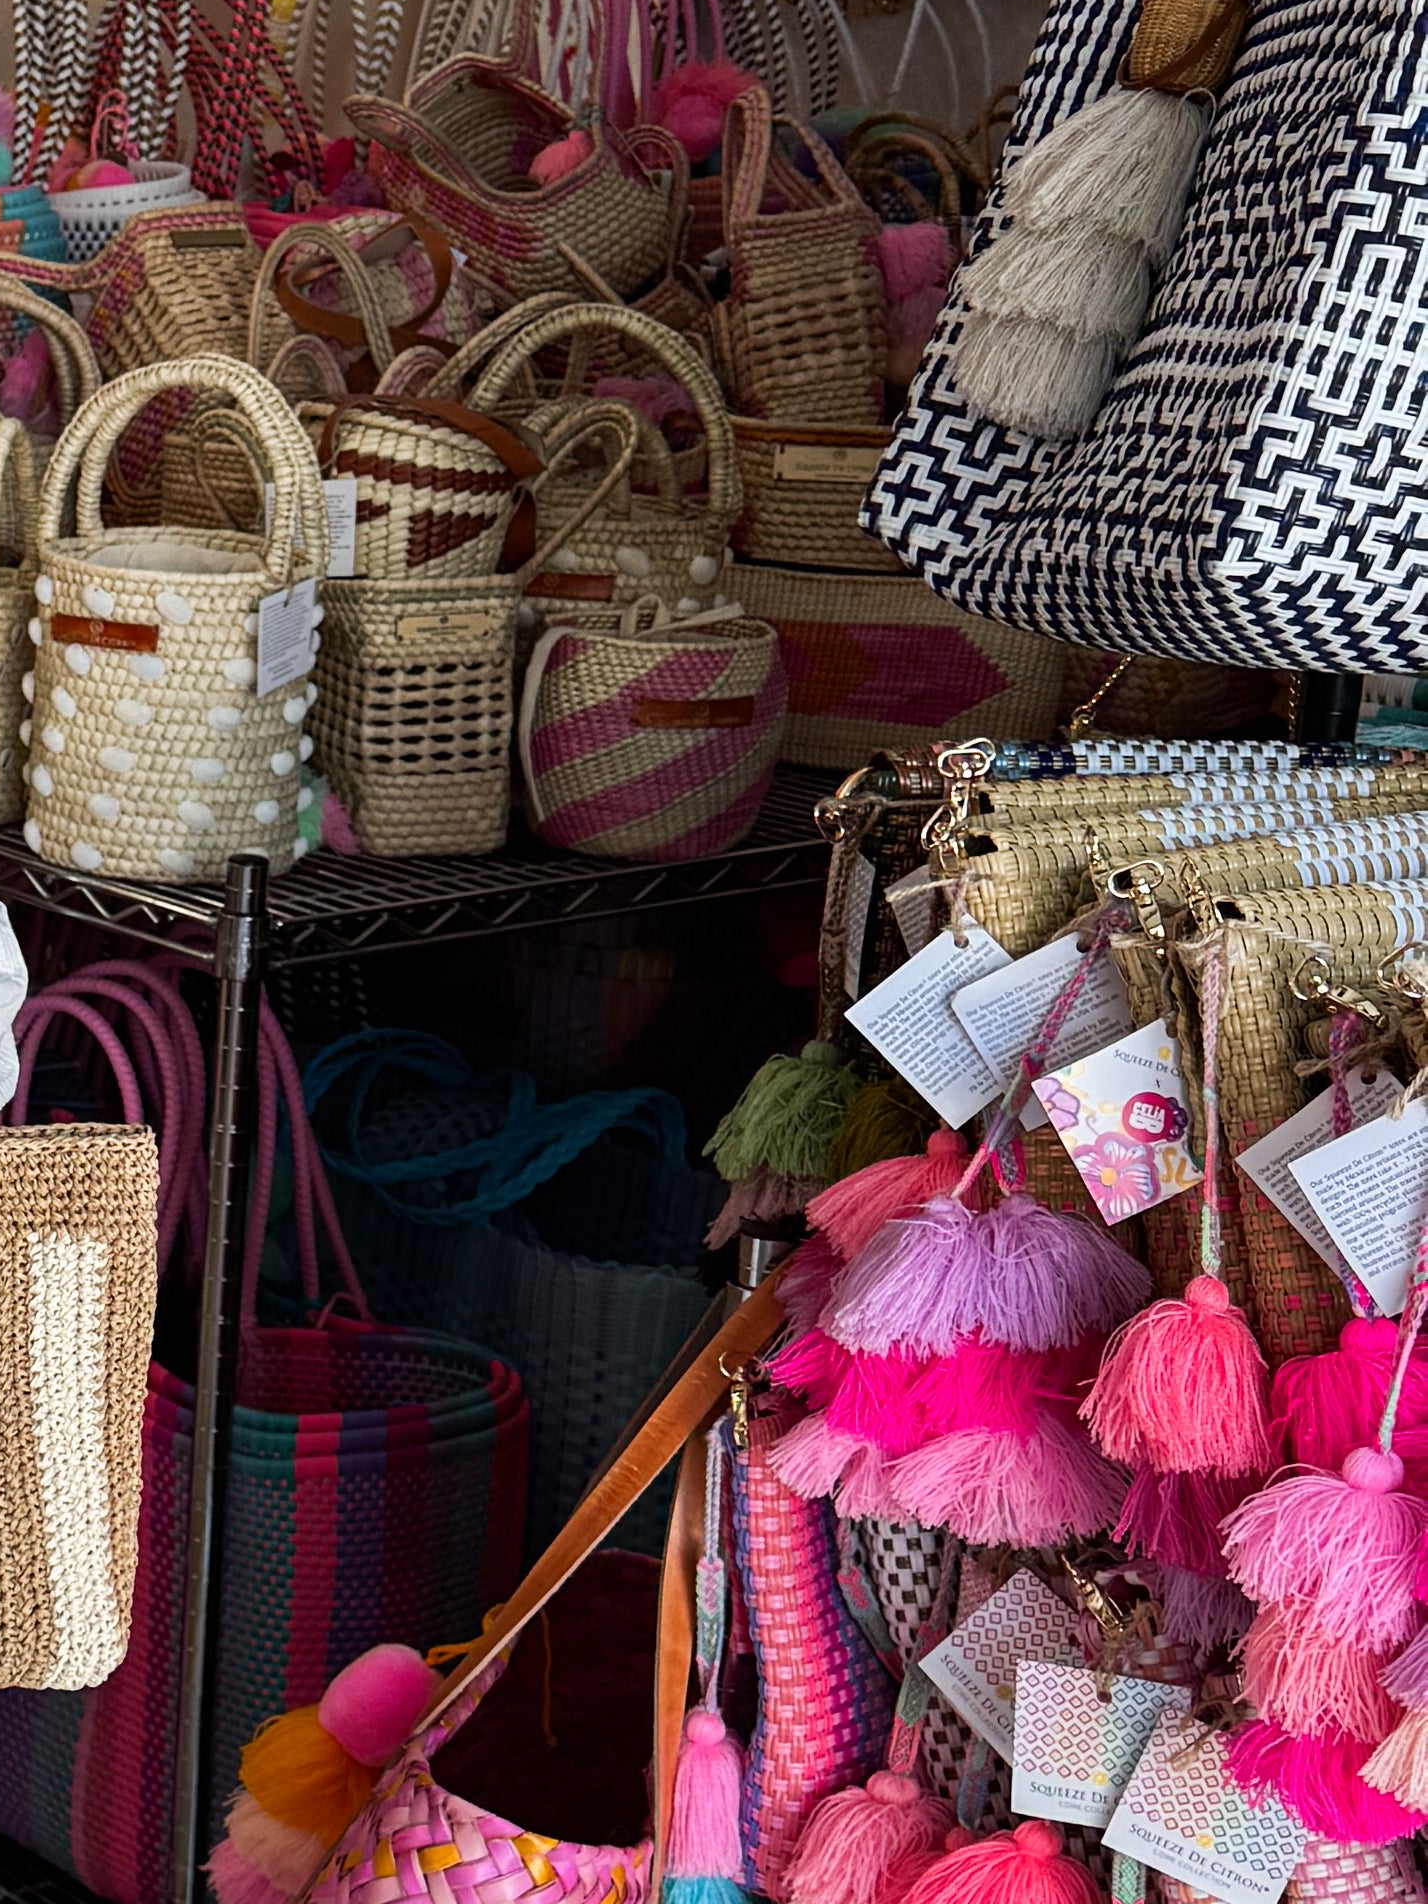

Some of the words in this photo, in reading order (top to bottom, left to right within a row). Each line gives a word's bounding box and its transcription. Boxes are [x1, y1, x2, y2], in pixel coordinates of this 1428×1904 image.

[939, 1652, 981, 1699] SQUEEZE
[980, 1697, 997, 1715] DE
[1030, 1781, 1085, 1801] SQUEEZE
[1092, 1792, 1107, 1804] DE
[1128, 1822, 1185, 1856] SQUEEZE
[1187, 1850, 1206, 1865] DE
